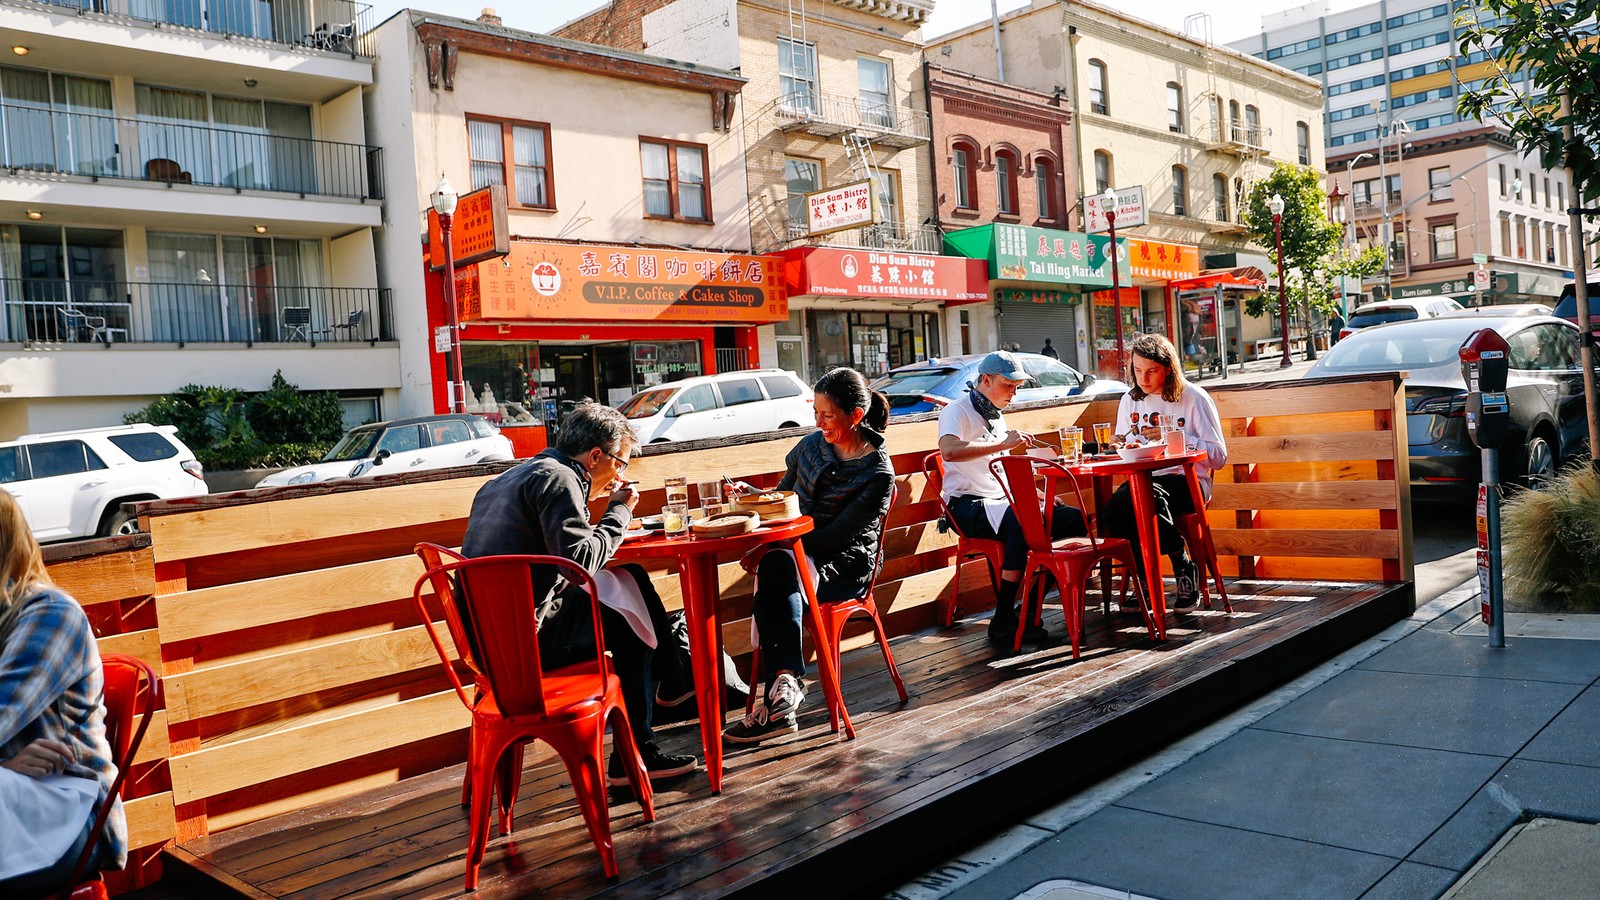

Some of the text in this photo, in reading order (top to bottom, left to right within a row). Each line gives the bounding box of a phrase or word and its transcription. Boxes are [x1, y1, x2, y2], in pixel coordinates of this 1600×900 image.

[811, 188, 868, 206] Dim Sum Bistro
[1121, 206, 1140, 214] Kitchen
[819, 213, 863, 228] 415-788-7028
[578, 251, 763, 283] 嘉賓閣咖啡餅店
[869, 253, 935, 267] Dim Sum Bistro
[1030, 261, 1104, 278] Tai Hing Market
[594, 286, 754, 306] V.I.P. Coffee & Cakes Shop
[824, 286, 848, 294] Broadway
[1402, 288, 1432, 298] Kum Luen
[782, 342, 794, 350] 673
[660, 350, 684, 360] OPEN
